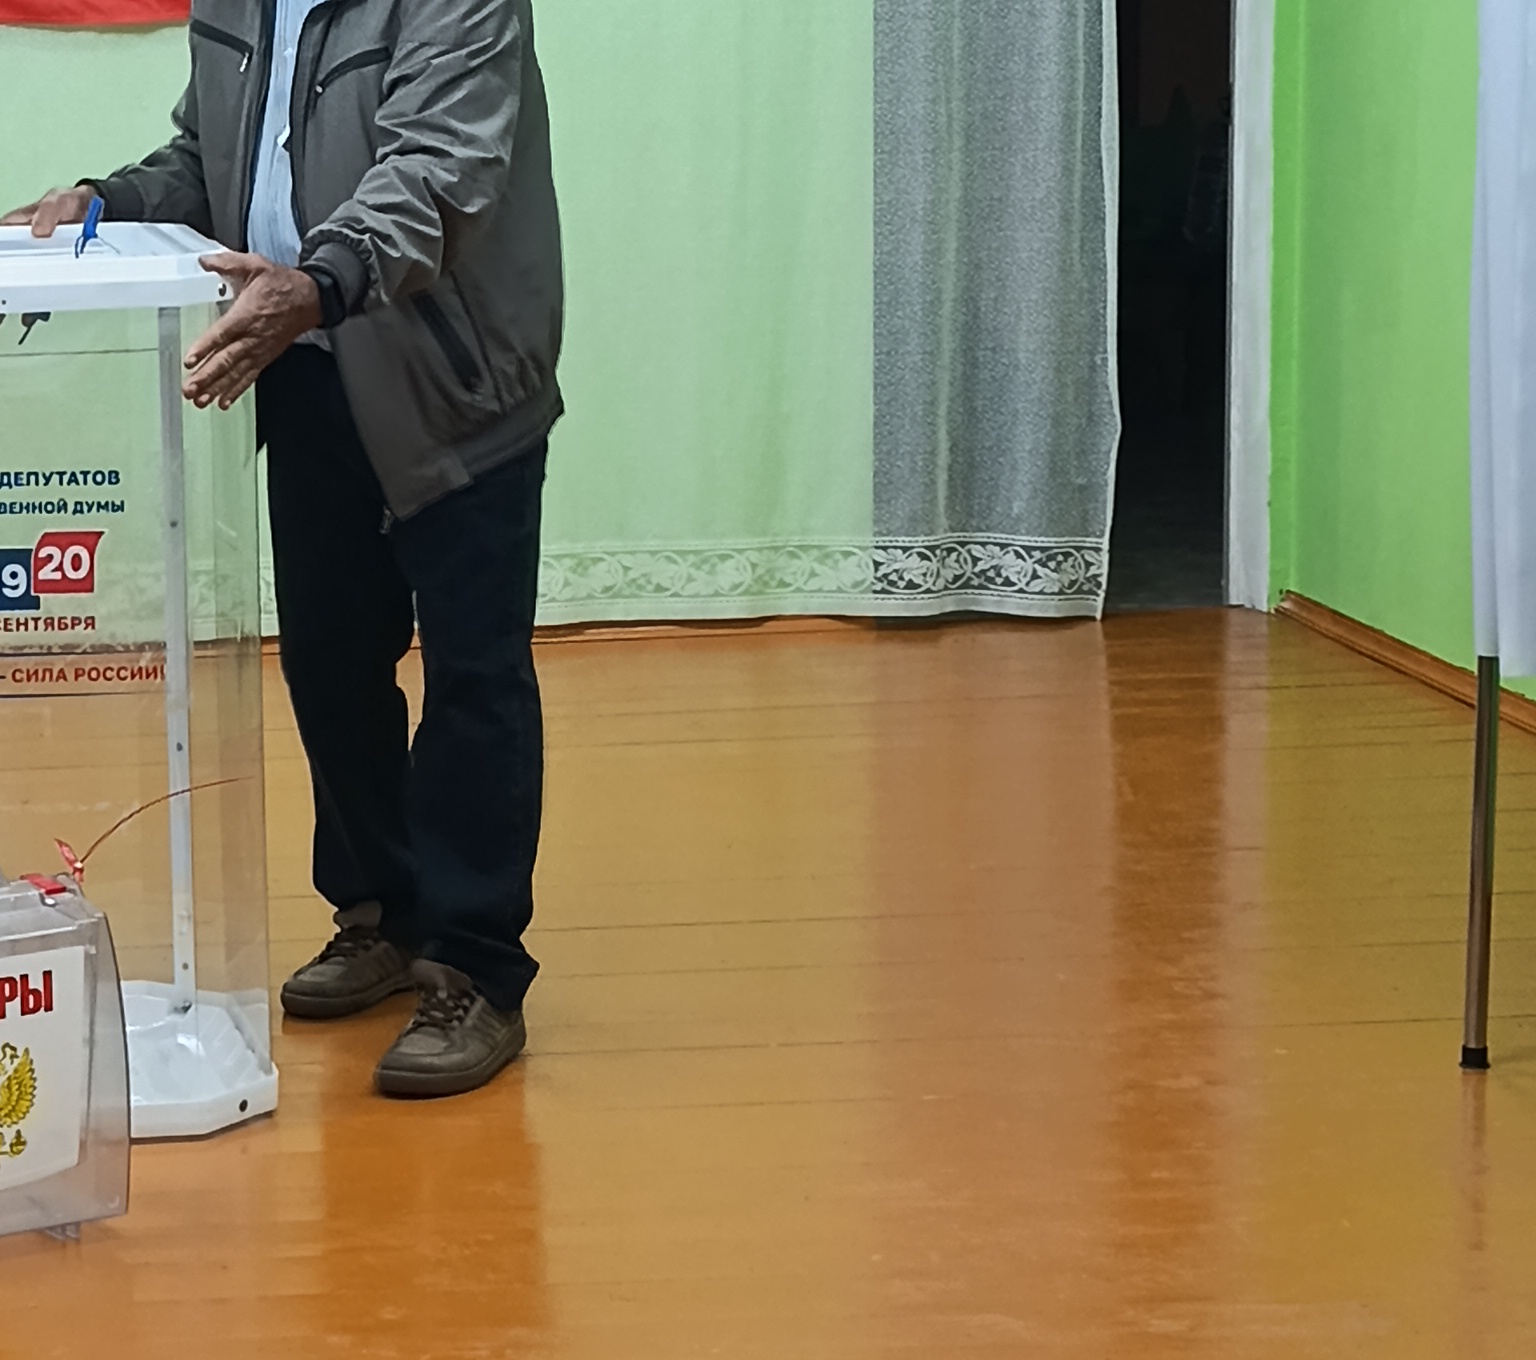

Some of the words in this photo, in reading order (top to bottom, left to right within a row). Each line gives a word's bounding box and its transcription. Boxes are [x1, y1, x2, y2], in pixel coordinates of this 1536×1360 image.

[72, 499, 125, 516] ДУМЫ
[37, 544, 91, 581] 20
[11, 667, 68, 684] СИЛА
